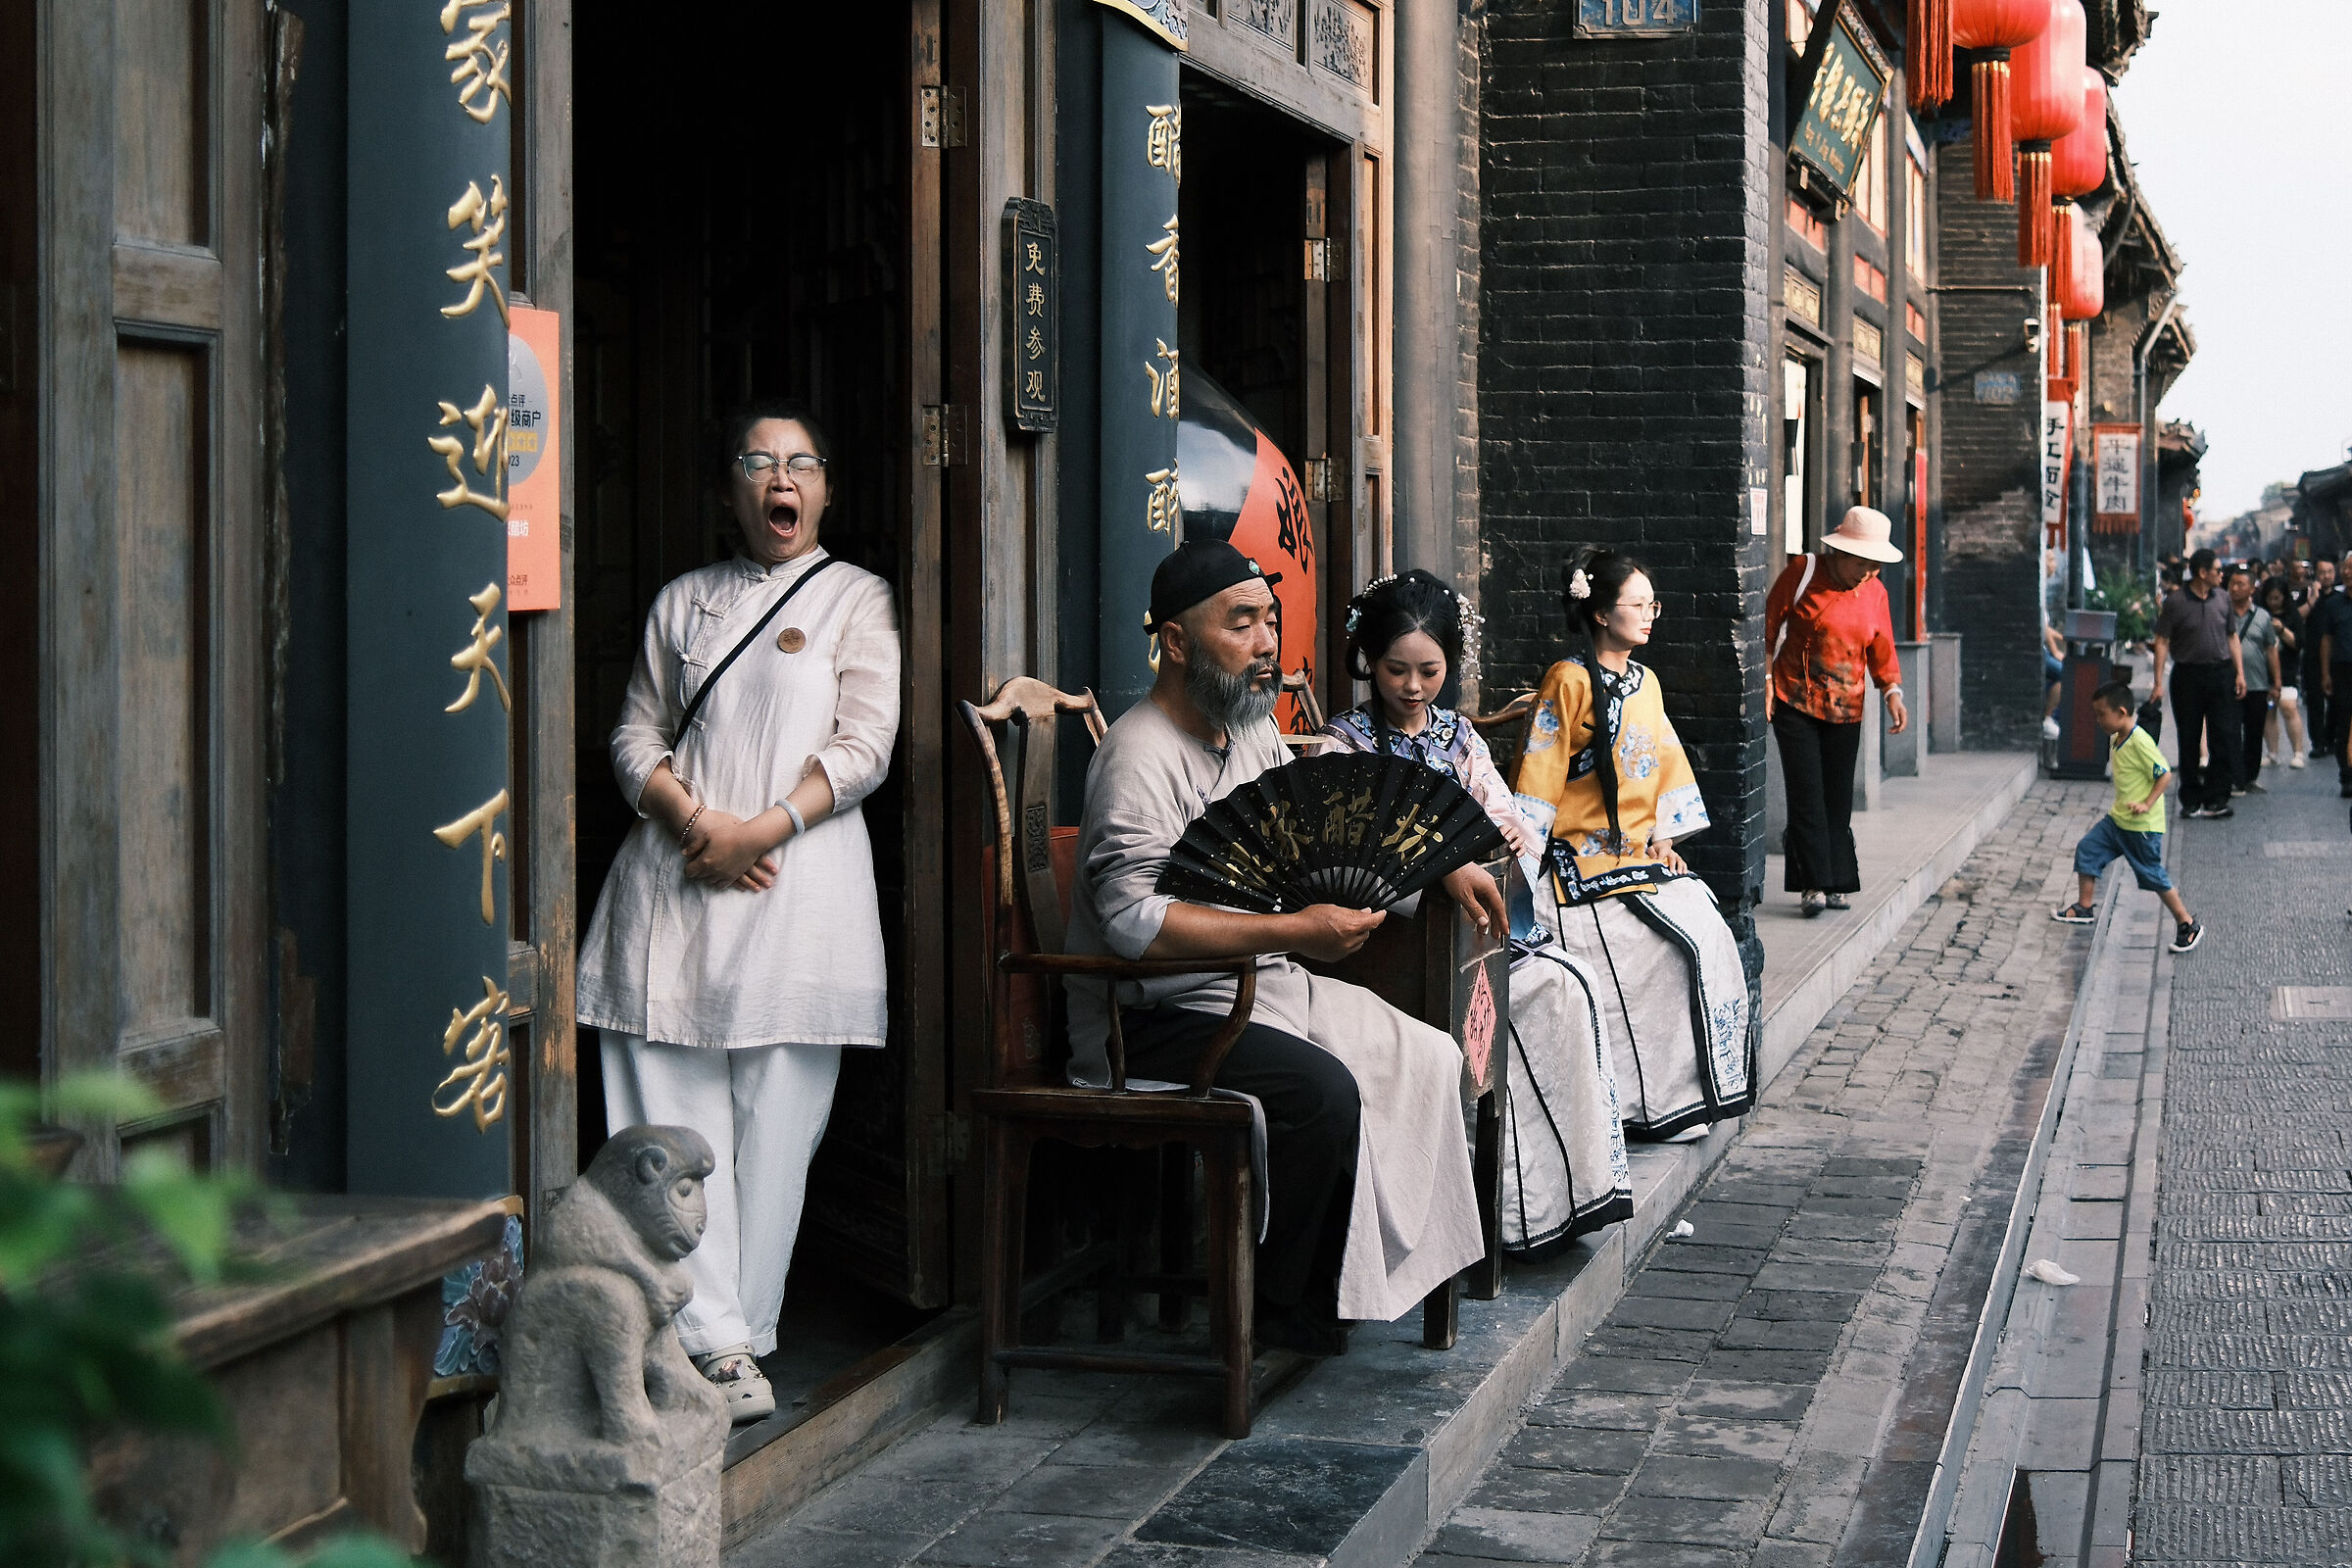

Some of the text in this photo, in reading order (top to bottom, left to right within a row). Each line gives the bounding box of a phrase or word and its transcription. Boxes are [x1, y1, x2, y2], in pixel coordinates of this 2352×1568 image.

[1602, 0, 1678, 25] 104
[1025, 241, 1047, 403] 免费参观
[1145, 98, 1181, 674] 醋香酒醉
[509, 394, 526, 408] 点评
[508, 455, 519, 466] 23
[508, 519, 529, 537] 醋坊
[508, 574, 528, 586] 众点评
